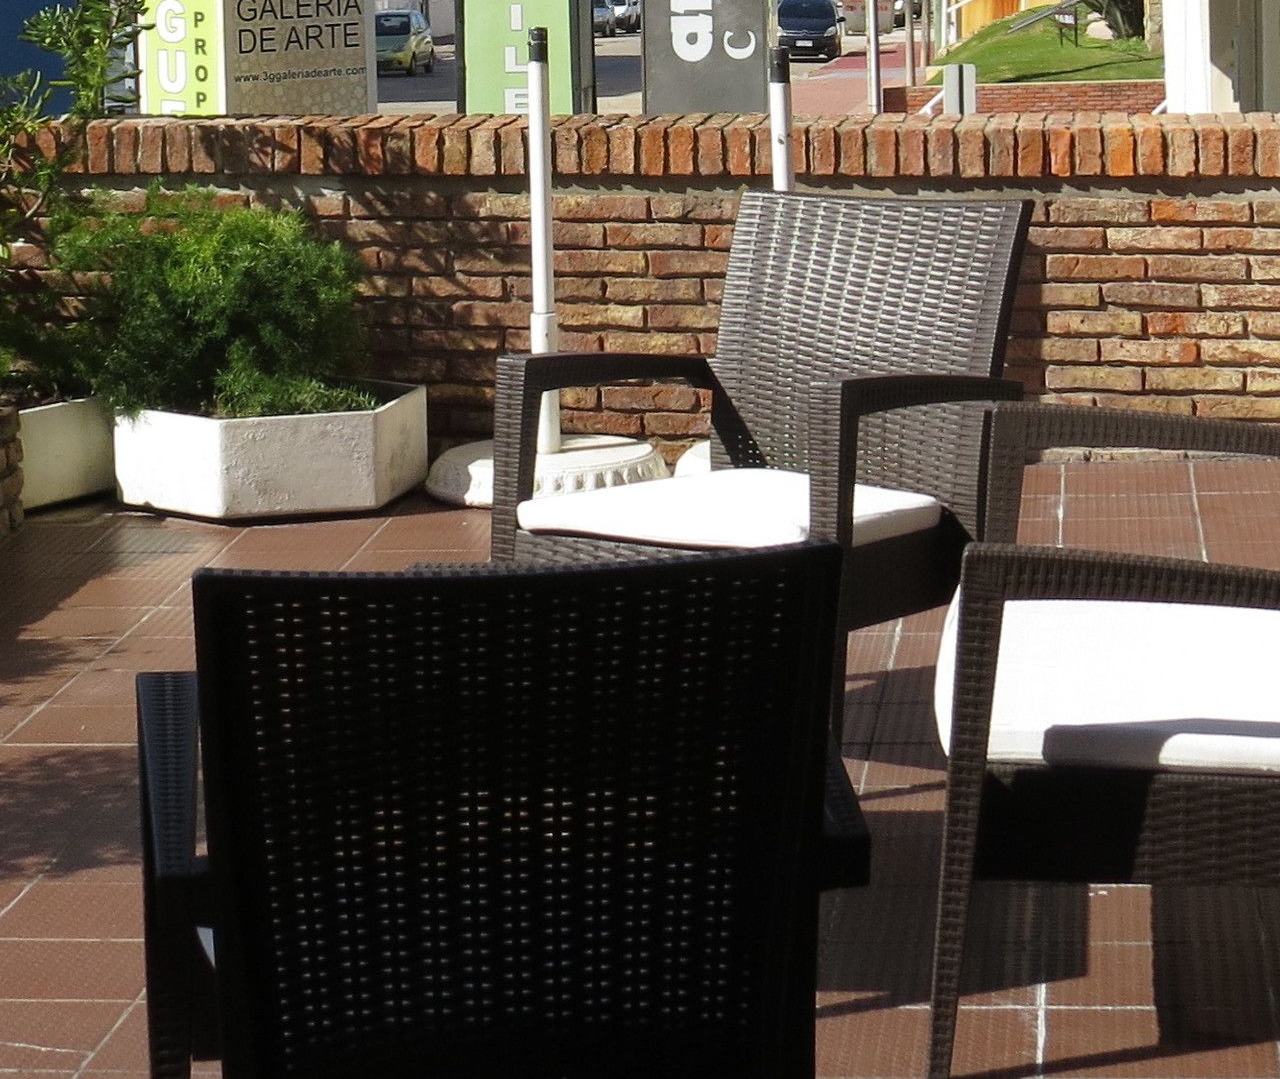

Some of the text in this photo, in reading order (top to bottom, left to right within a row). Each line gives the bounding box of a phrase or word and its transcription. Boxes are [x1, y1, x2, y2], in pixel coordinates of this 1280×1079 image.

[238, 22, 360, 54] DE ARTE
[234, 66, 367, 83] www.3ggaleriadearte.com
